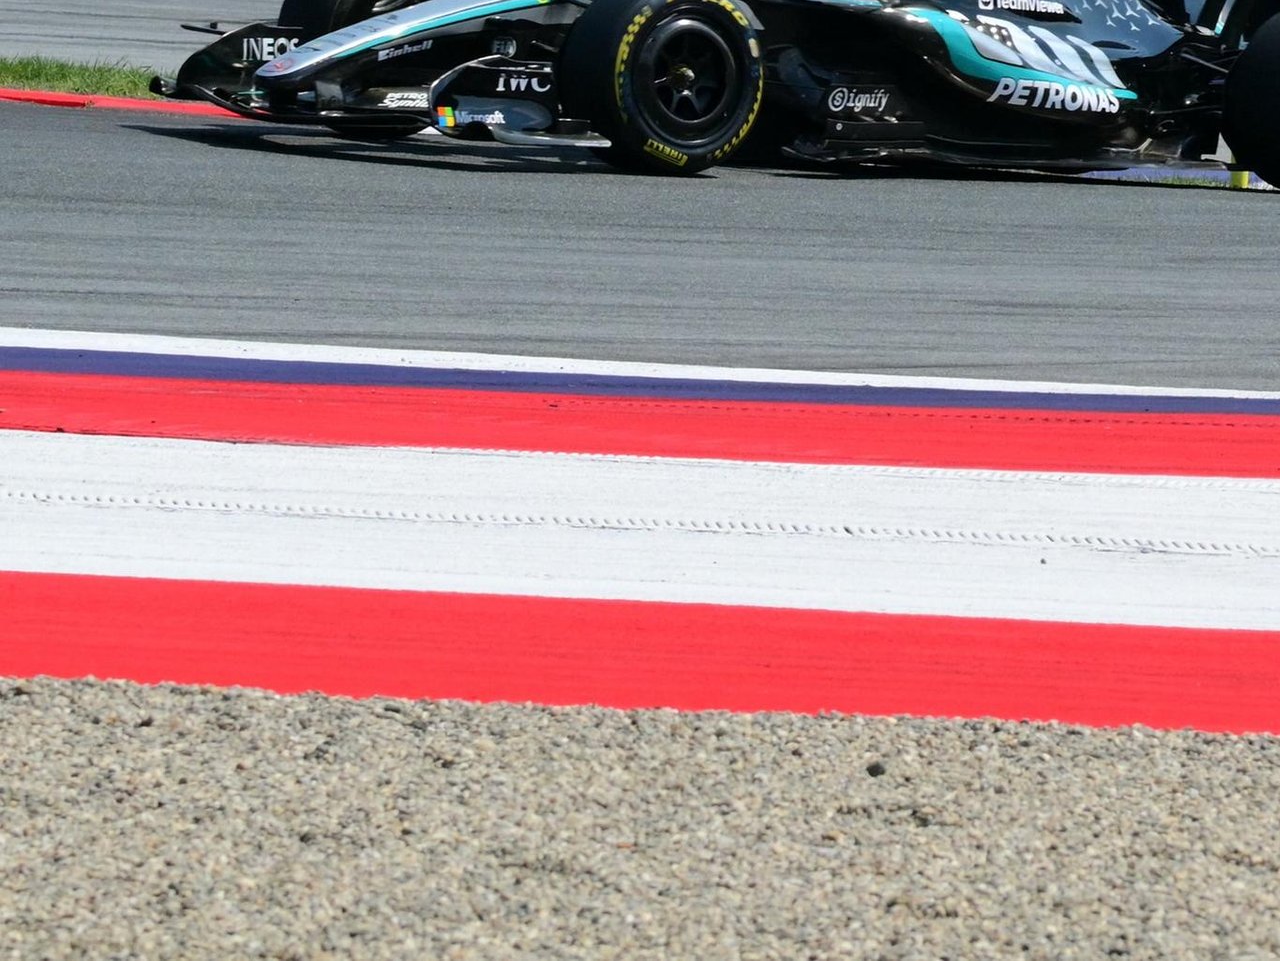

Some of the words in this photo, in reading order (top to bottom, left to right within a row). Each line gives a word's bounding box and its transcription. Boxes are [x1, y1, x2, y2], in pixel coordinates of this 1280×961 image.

[242, 37, 299, 62] INEOS
[377, 39, 434, 62] Einhell
[495, 73, 551, 93] IWC
[987, 77, 1120, 114] PETRONAS
[455, 110, 506, 124] Microsoft
[644, 138, 689, 168] PIRELLI
